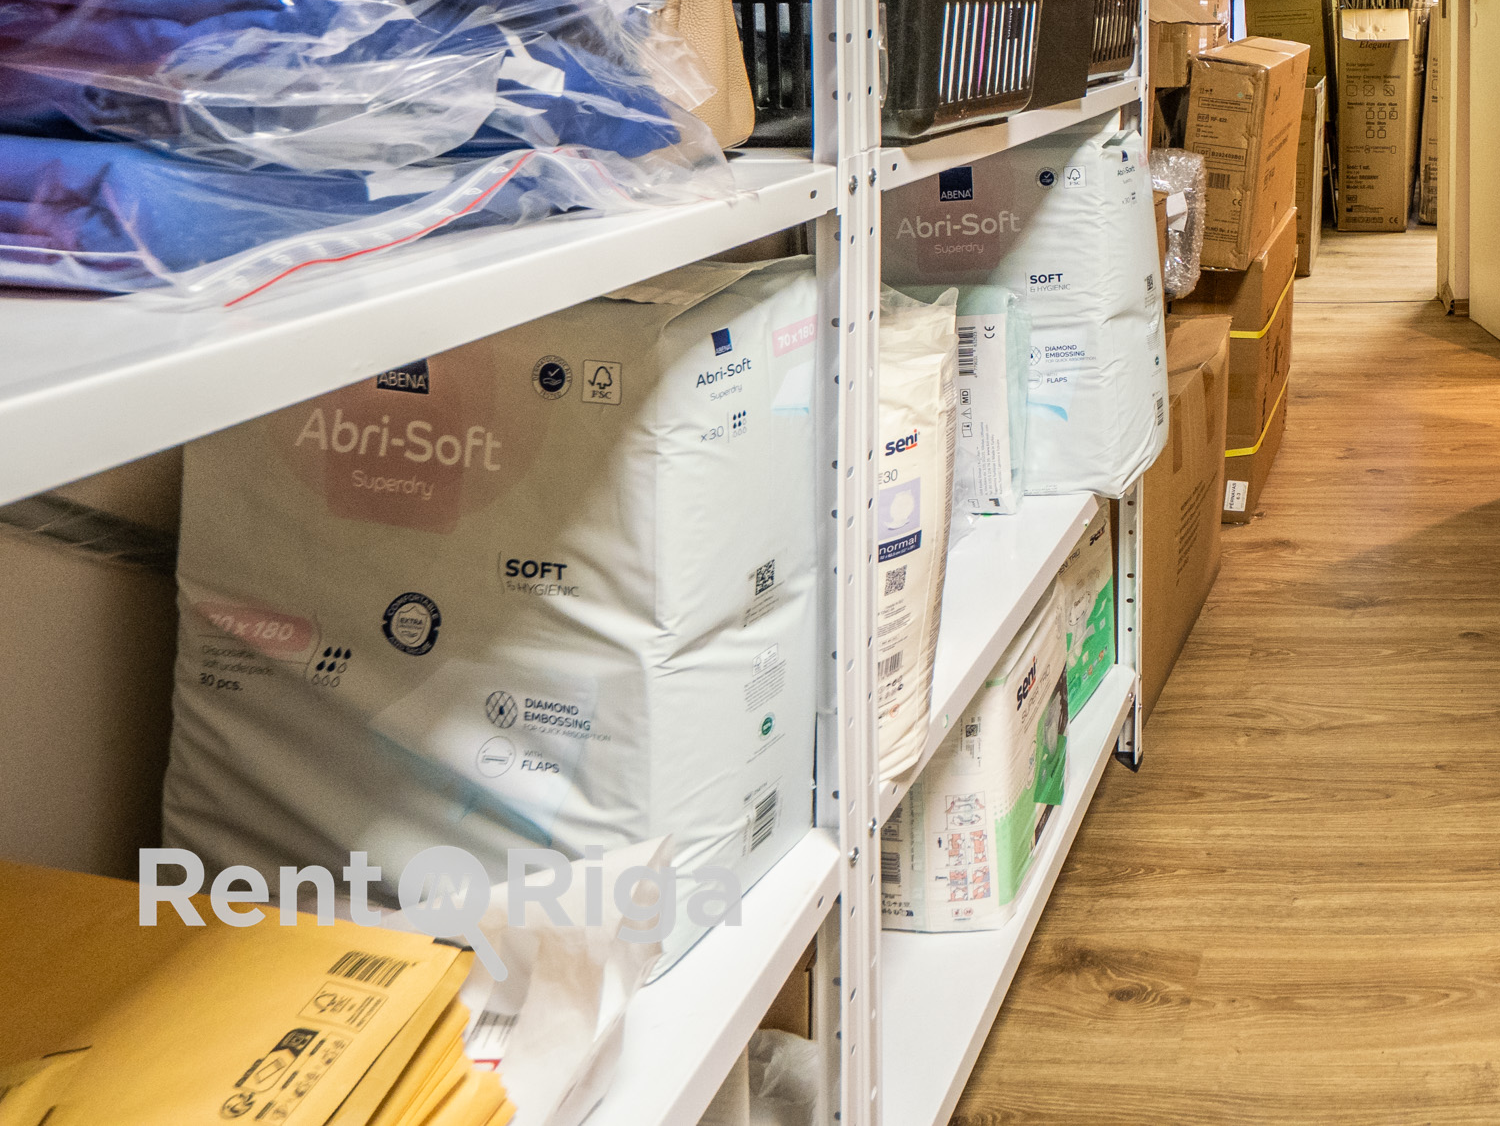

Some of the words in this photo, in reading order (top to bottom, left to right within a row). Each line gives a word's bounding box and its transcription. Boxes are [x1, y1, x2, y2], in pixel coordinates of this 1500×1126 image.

[1359, 41, 1391, 50] Elegant
[940, 190, 972, 200] ABENA
[896, 210, 1022, 240] Abri-Soft
[934, 241, 984, 254] Superdry
[1030, 273, 1063, 284] SOFT
[1037, 284, 1071, 292] HYGIENIC
[1045, 351, 1085, 359] EMBOSSING
[378, 371, 428, 390] ABENA
[696, 357, 752, 389] Abri-Soft
[591, 390, 612, 400] FSC
[710, 384, 743, 401] Superdry
[961, 390, 969, 403] MD
[294, 407, 501, 472] Abri-Soft
[885, 428, 918, 457] seni
[351, 469, 435, 501] Superdry
[879, 534, 918, 555] normal
[505, 559, 567, 580] SOFT
[517, 581, 580, 597] HYGIENIC
[1016, 655, 1036, 712] seni
[525, 698, 579, 715] DIAMOND
[524, 712, 591, 731] EMBOSSING
[521, 759, 560, 774] FLAPS
